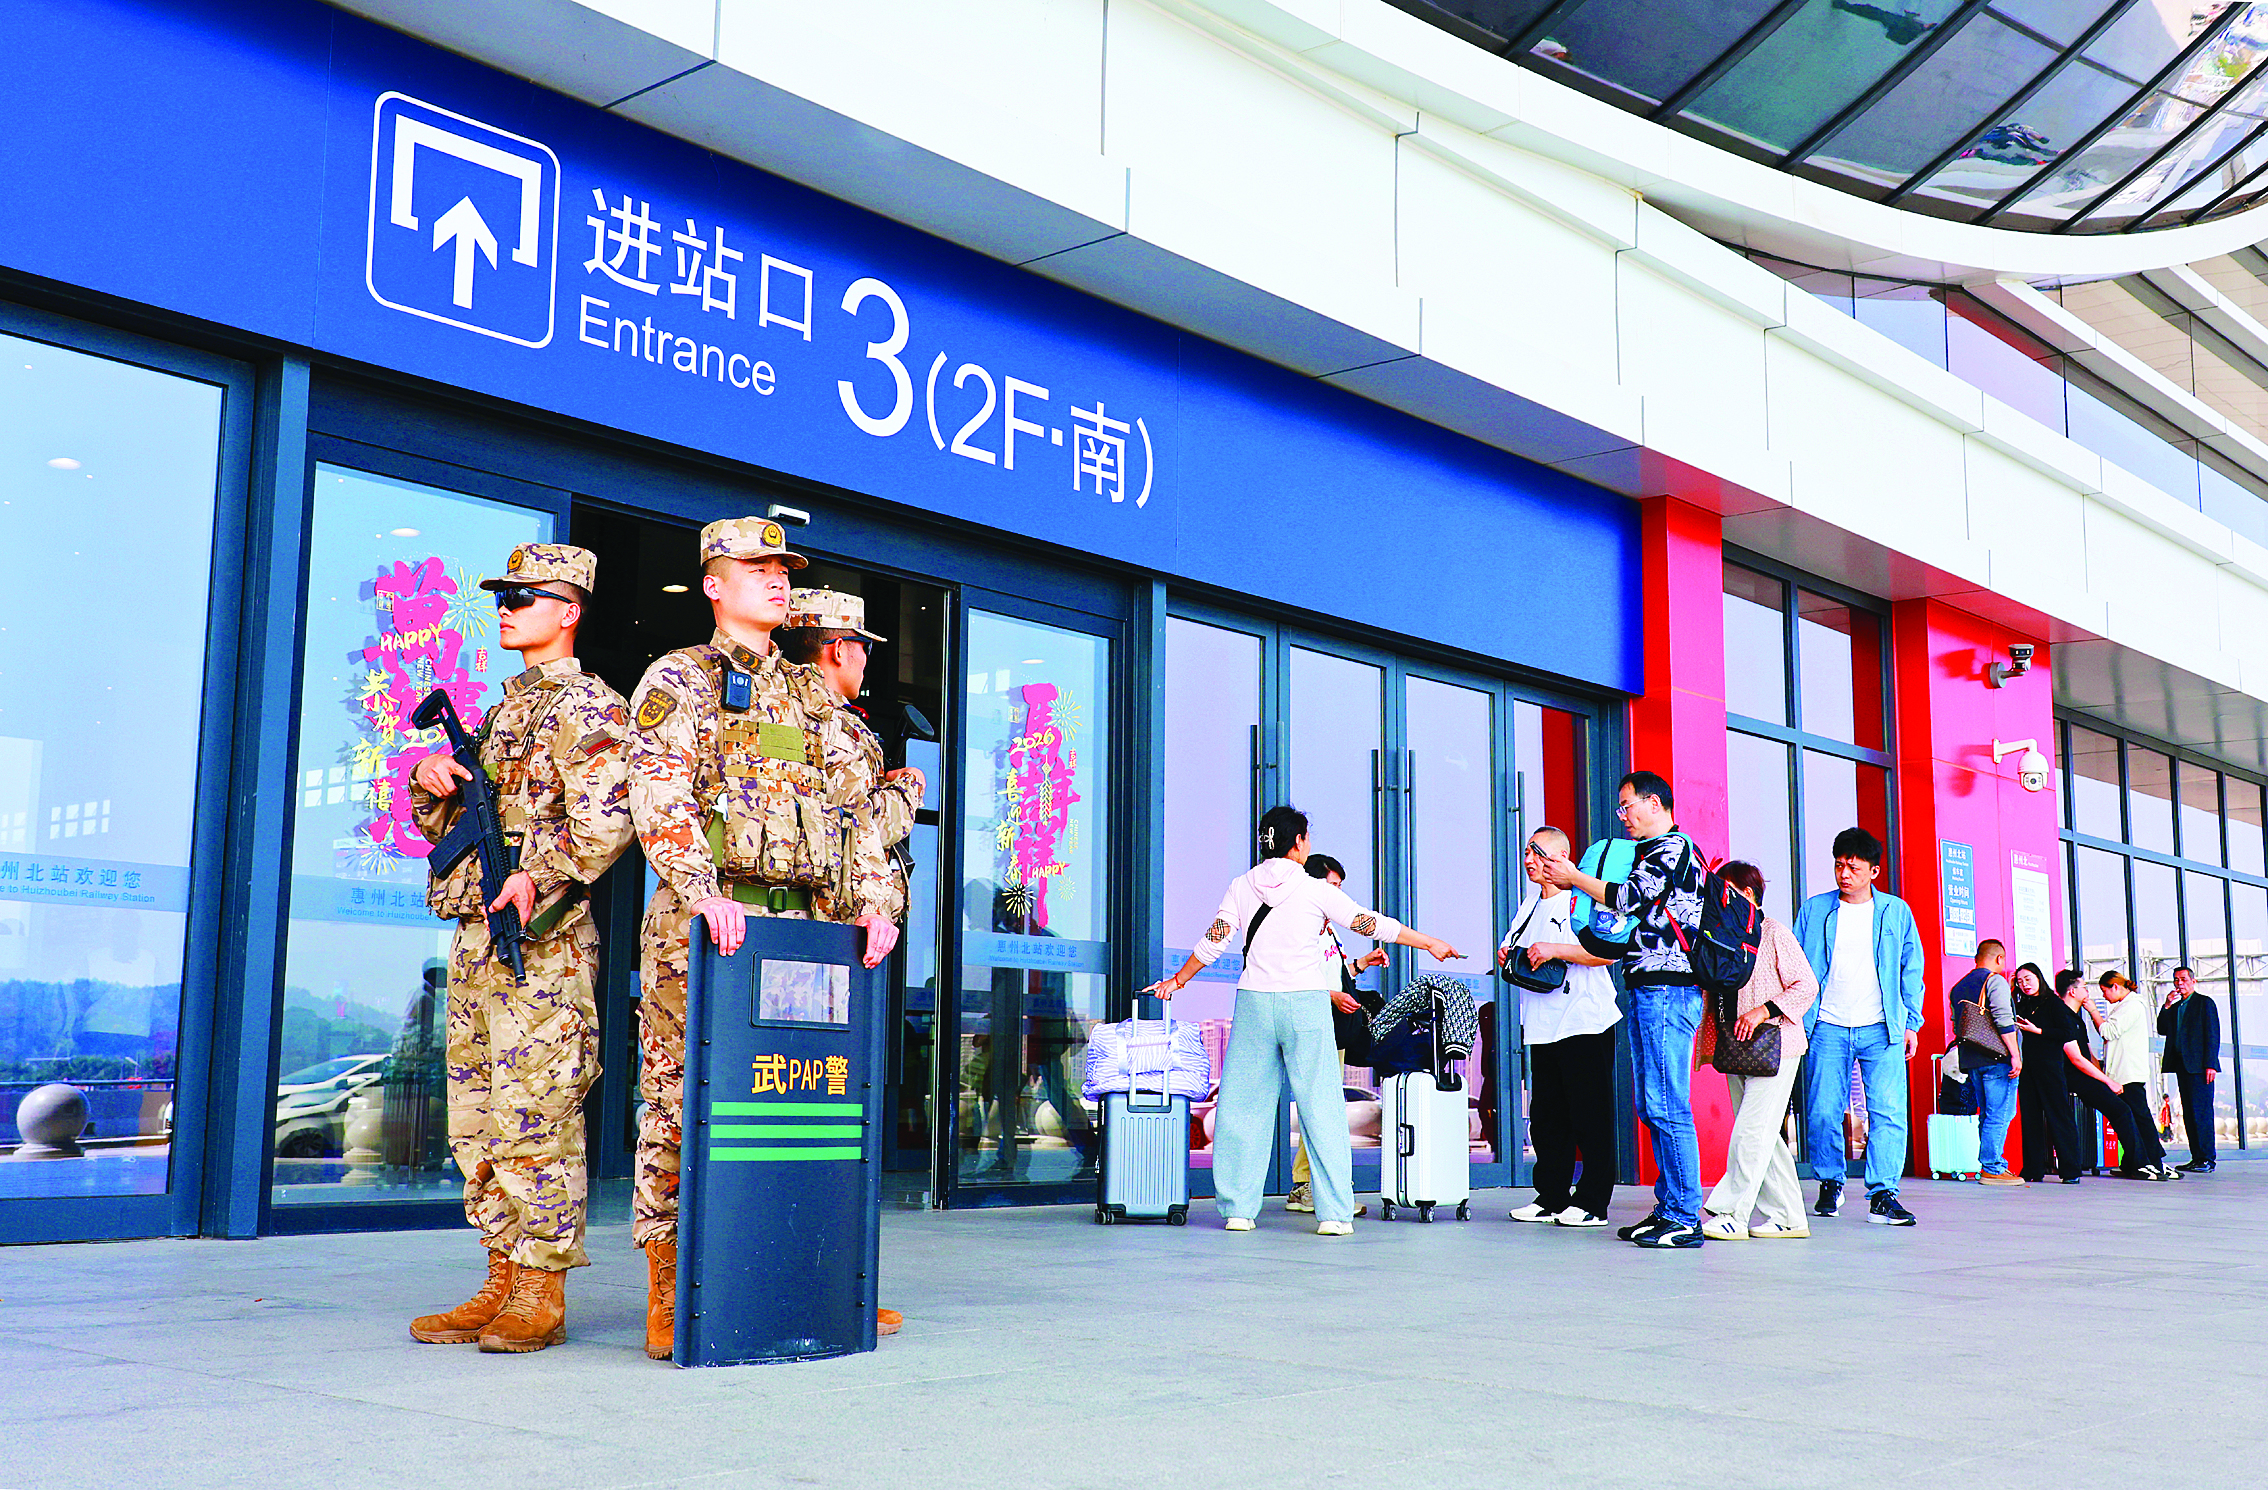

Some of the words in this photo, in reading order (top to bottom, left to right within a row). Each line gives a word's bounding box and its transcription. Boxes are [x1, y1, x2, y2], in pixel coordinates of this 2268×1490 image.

[582, 187, 815, 342] 进站口
[579, 294, 777, 396] Entrance
[380, 622, 443, 652] HAPPY
[416, 657, 424, 677] NEW
[1010, 727, 1056, 755] 2026
[1031, 861, 1067, 879] HAPPY
[22, 886, 78, 897] Huizhoubei
[81, 889, 119, 902] Railway
[122, 892, 155, 903] Station
[337, 906, 374, 917] Welcome
[997, 940, 1078, 958] 惠州北站欢迎您
